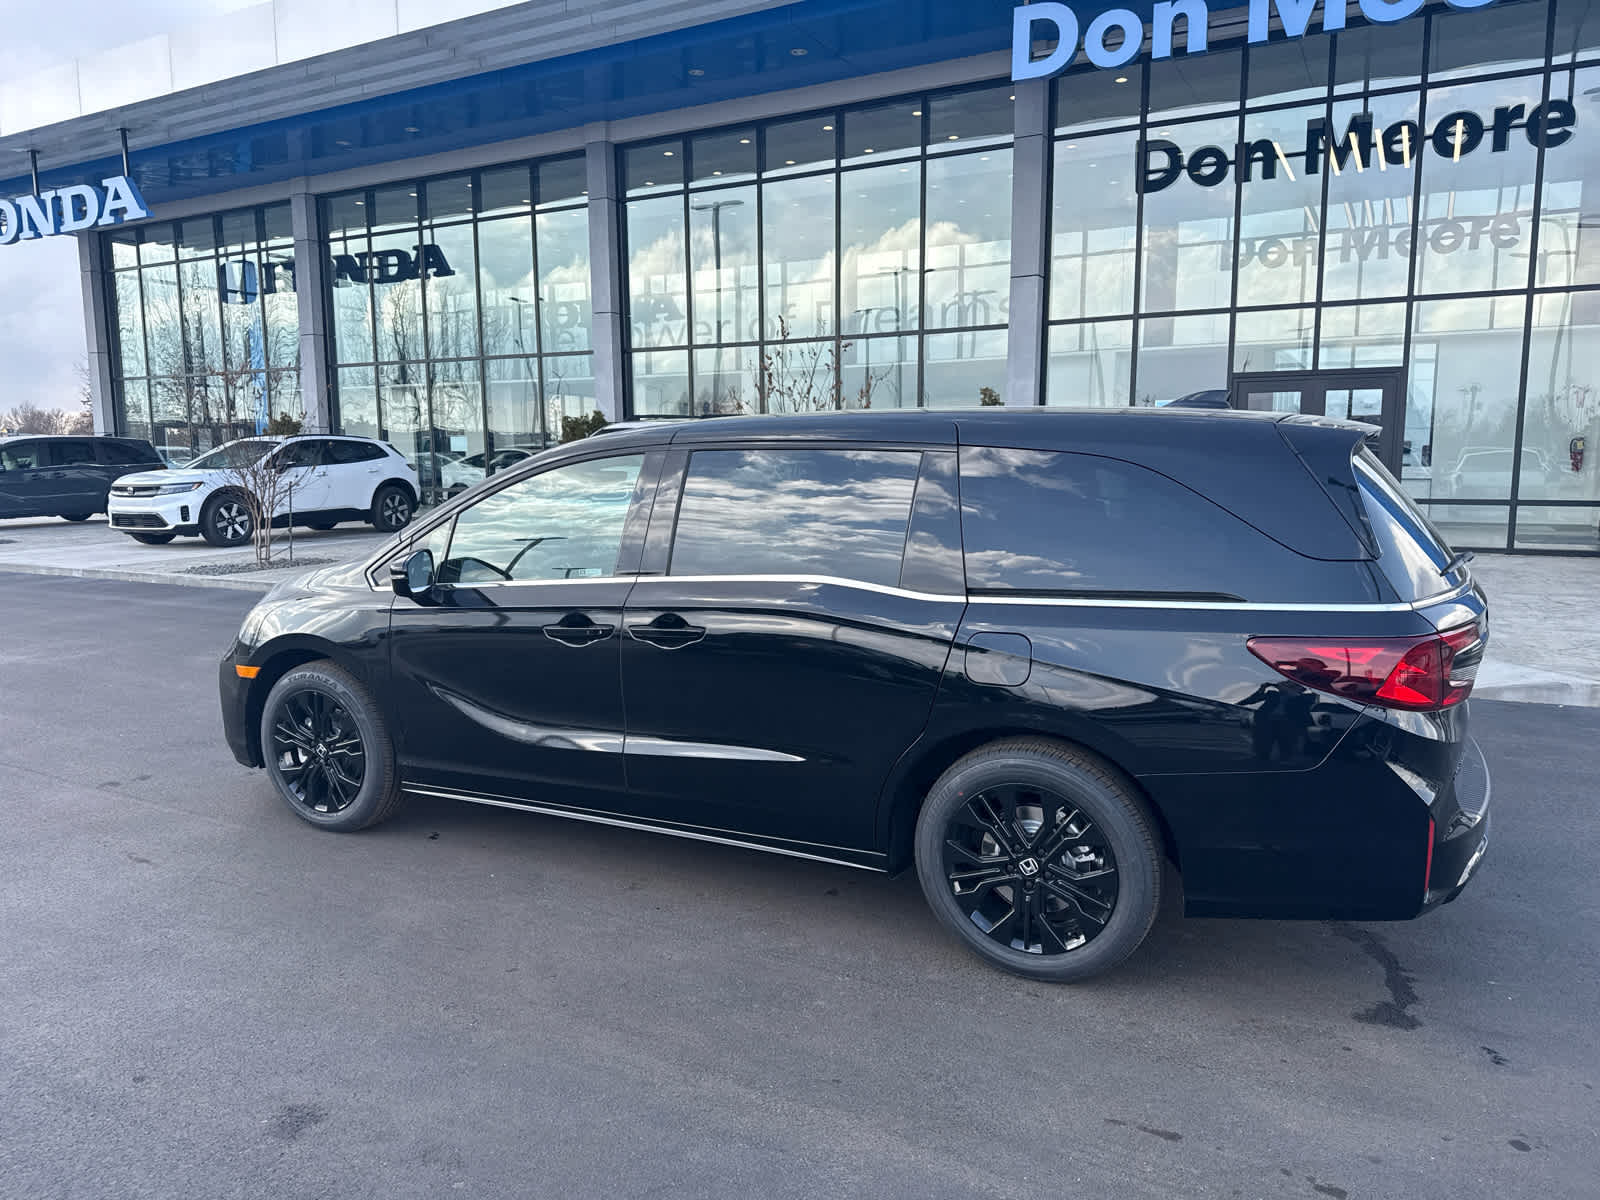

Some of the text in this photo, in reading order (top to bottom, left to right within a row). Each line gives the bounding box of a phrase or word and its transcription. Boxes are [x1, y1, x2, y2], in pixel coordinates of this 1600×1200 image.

[1010, 0, 1208, 82] Don
[1136, 98, 1577, 194] Don Moore
